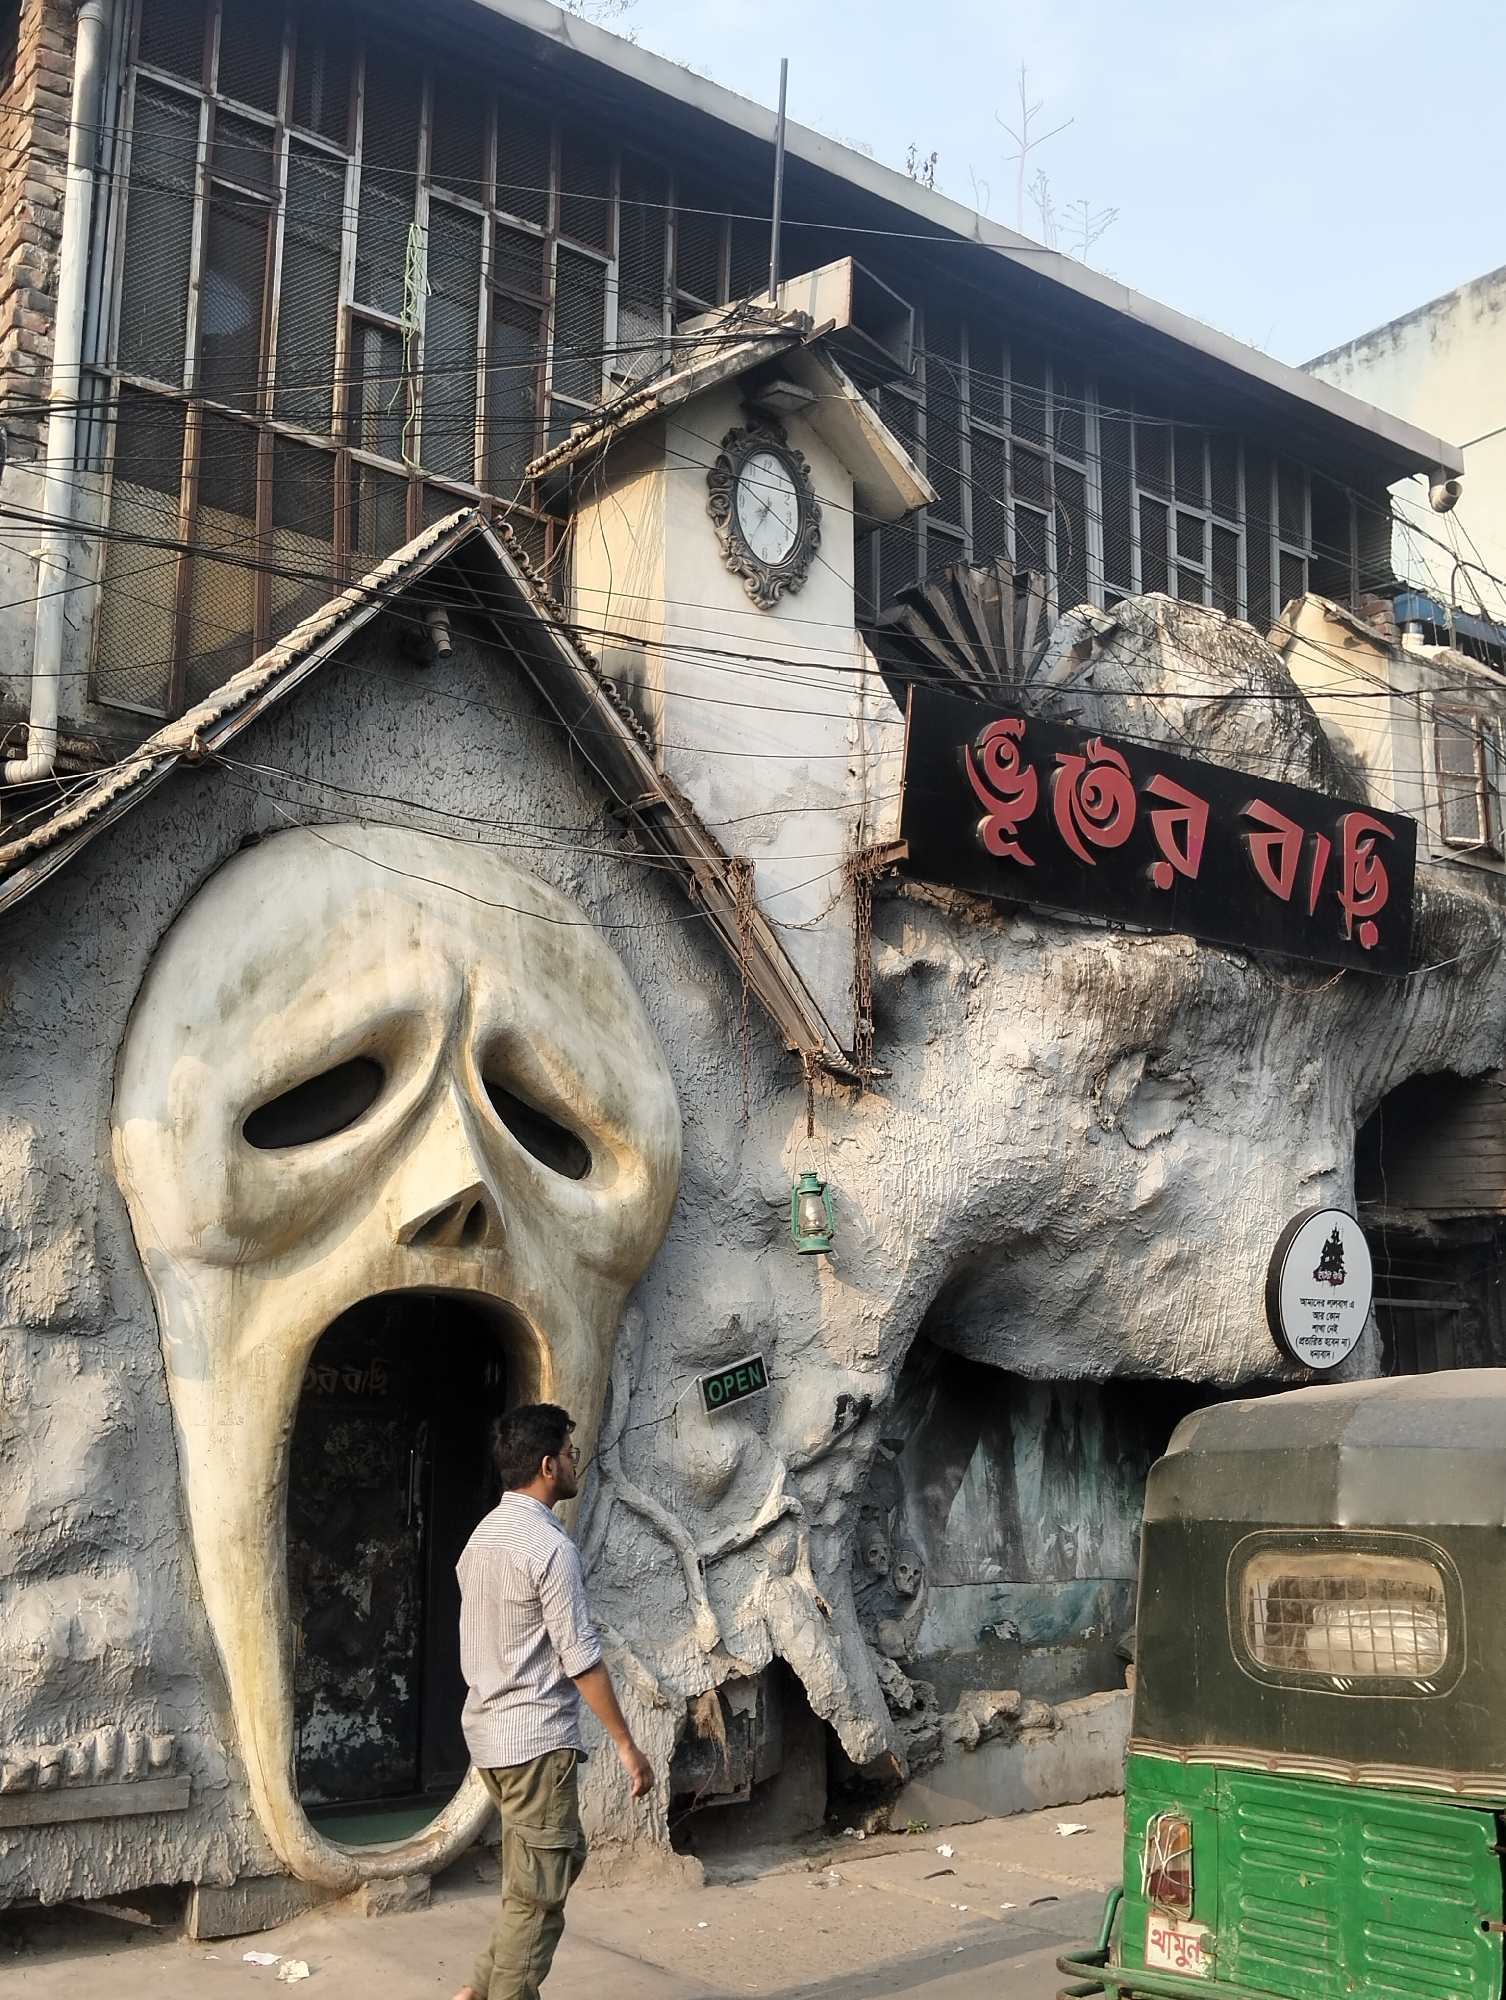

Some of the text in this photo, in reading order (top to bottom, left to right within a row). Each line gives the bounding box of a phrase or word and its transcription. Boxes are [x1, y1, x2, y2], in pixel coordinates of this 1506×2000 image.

[739, 494, 746, 509] 9
[784, 494, 791, 507] 2
[740, 513, 748, 528] 8
[786, 510, 793, 525] 3
[761, 546, 769, 560] 6
[1239, 798, 1395, 949] বাড়ি
[708, 1363, 763, 1402] OPEN
[1151, 1928, 1201, 1968] থামুন
